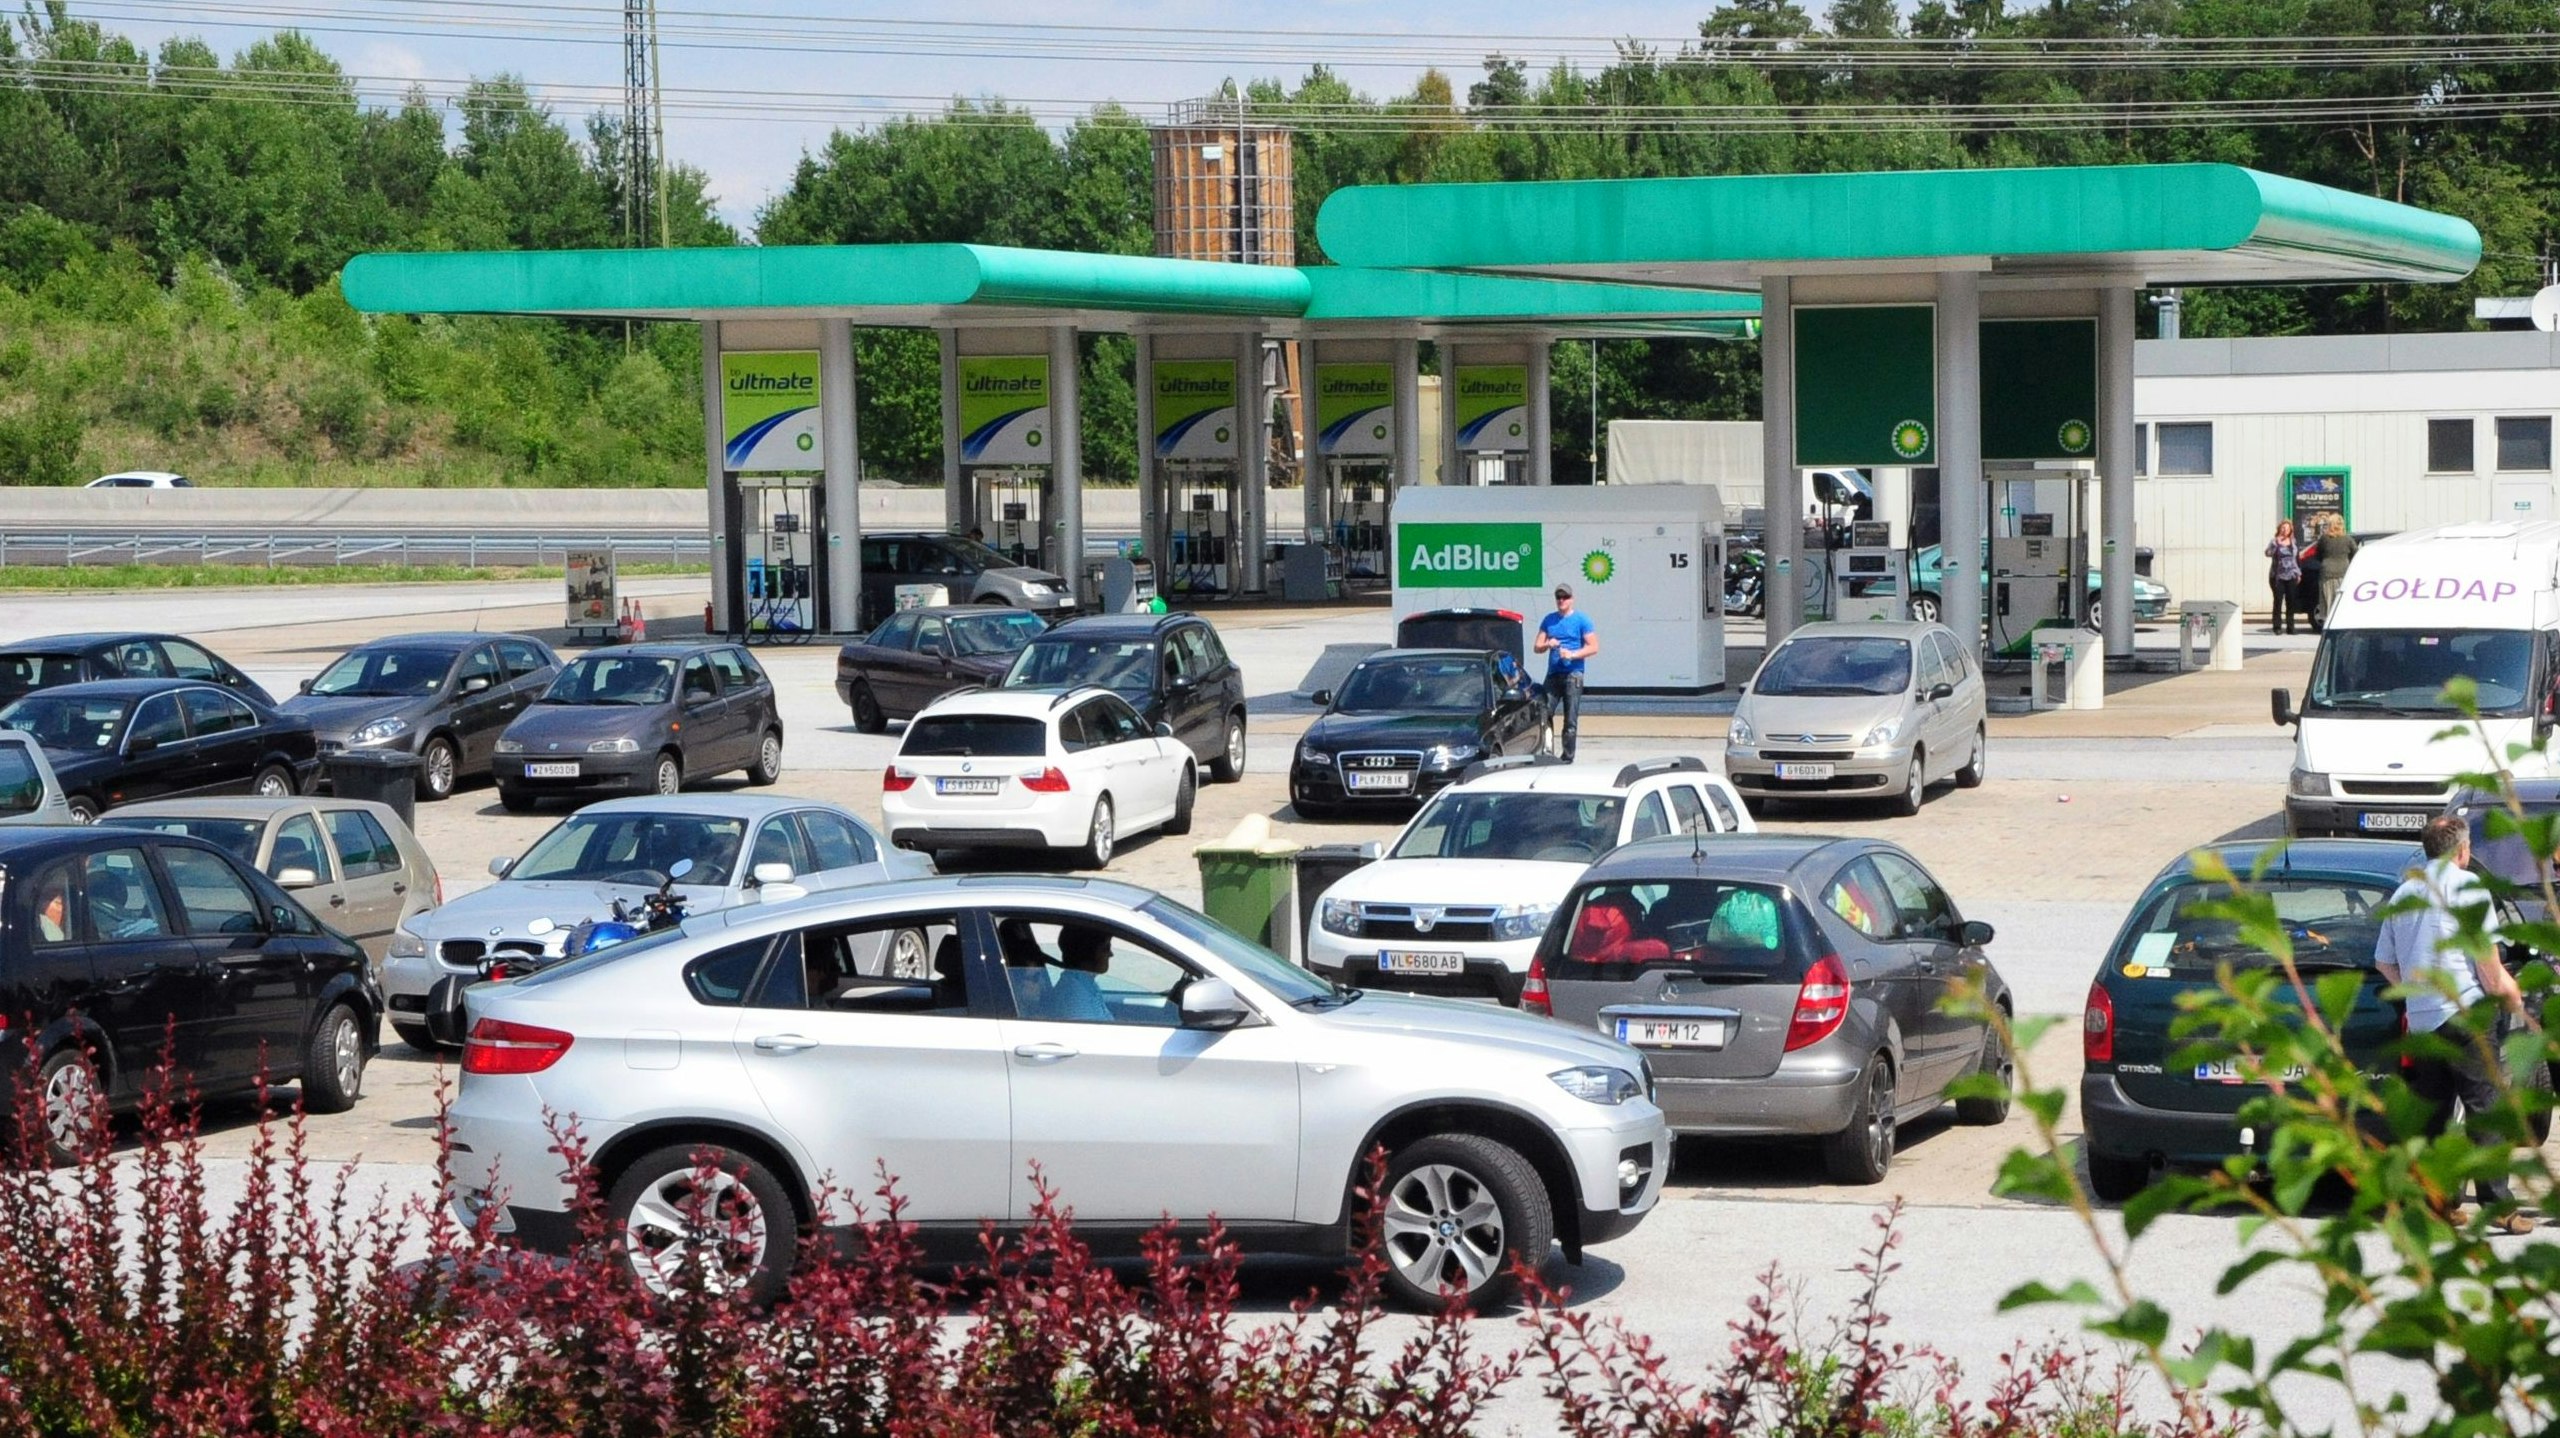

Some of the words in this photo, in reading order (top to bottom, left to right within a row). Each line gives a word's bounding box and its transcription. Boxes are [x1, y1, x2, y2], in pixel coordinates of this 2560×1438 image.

[730, 372, 813, 390] ultimate
[966, 374, 1042, 391] ultimate
[1160, 378, 1230, 392] ultimate
[1322, 380, 1388, 393] ultimate
[1461, 381, 1522, 393] ultimate
[2296, 493, 2340, 501] HOLLYWOOD
[1602, 537, 1616, 549] bp
[1669, 553, 1689, 568] 15
[2353, 578, 2517, 602] GOŁDAP
[2366, 815, 2392, 827] NGO
[1390, 955, 1404, 968] VL
[1413, 955, 1438, 969] 680
[1440, 956, 1458, 969] AB
[1683, 1023, 1700, 1041] 12
